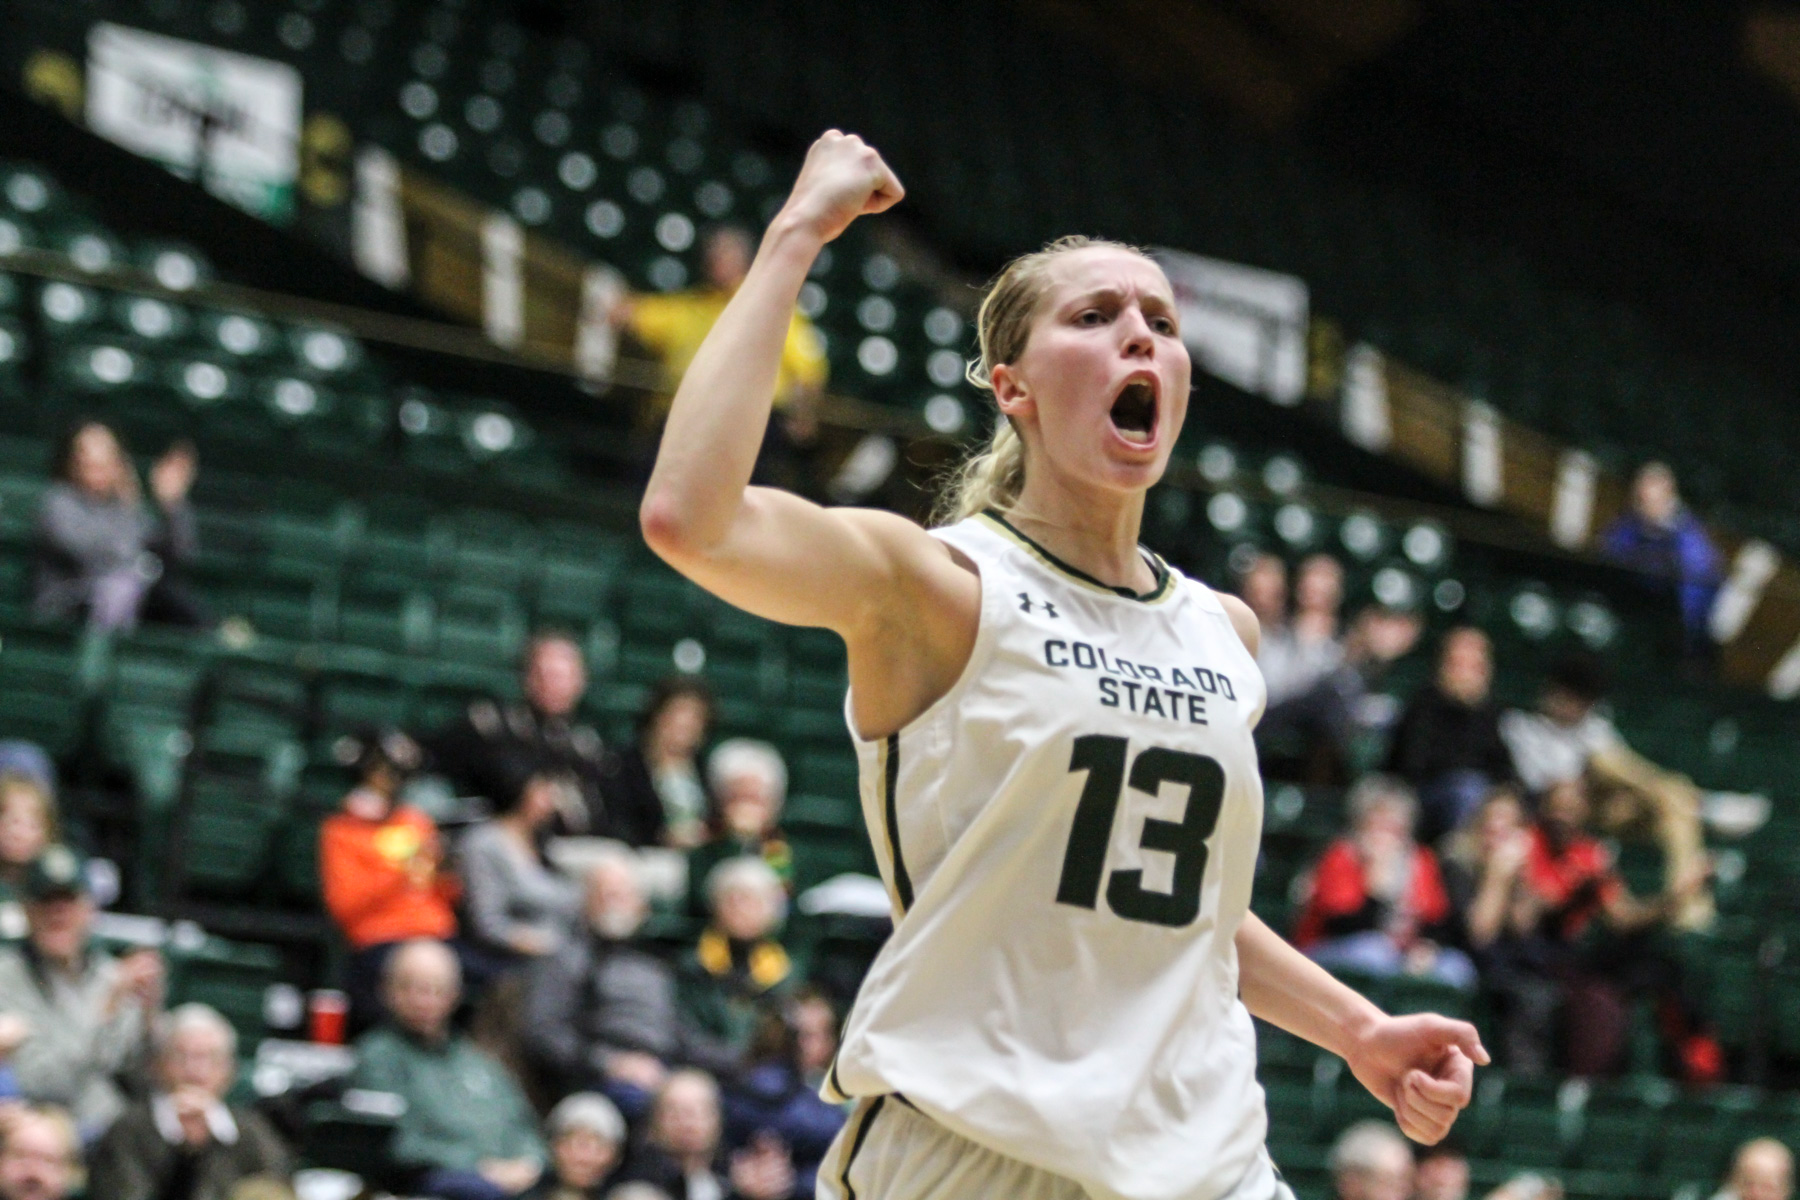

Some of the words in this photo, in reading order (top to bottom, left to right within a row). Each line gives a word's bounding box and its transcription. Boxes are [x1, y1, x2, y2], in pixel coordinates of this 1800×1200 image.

[1044, 639, 1237, 701] COLORADO
[1099, 677, 1208, 725] STATE
[1056, 733, 1226, 928] 13
